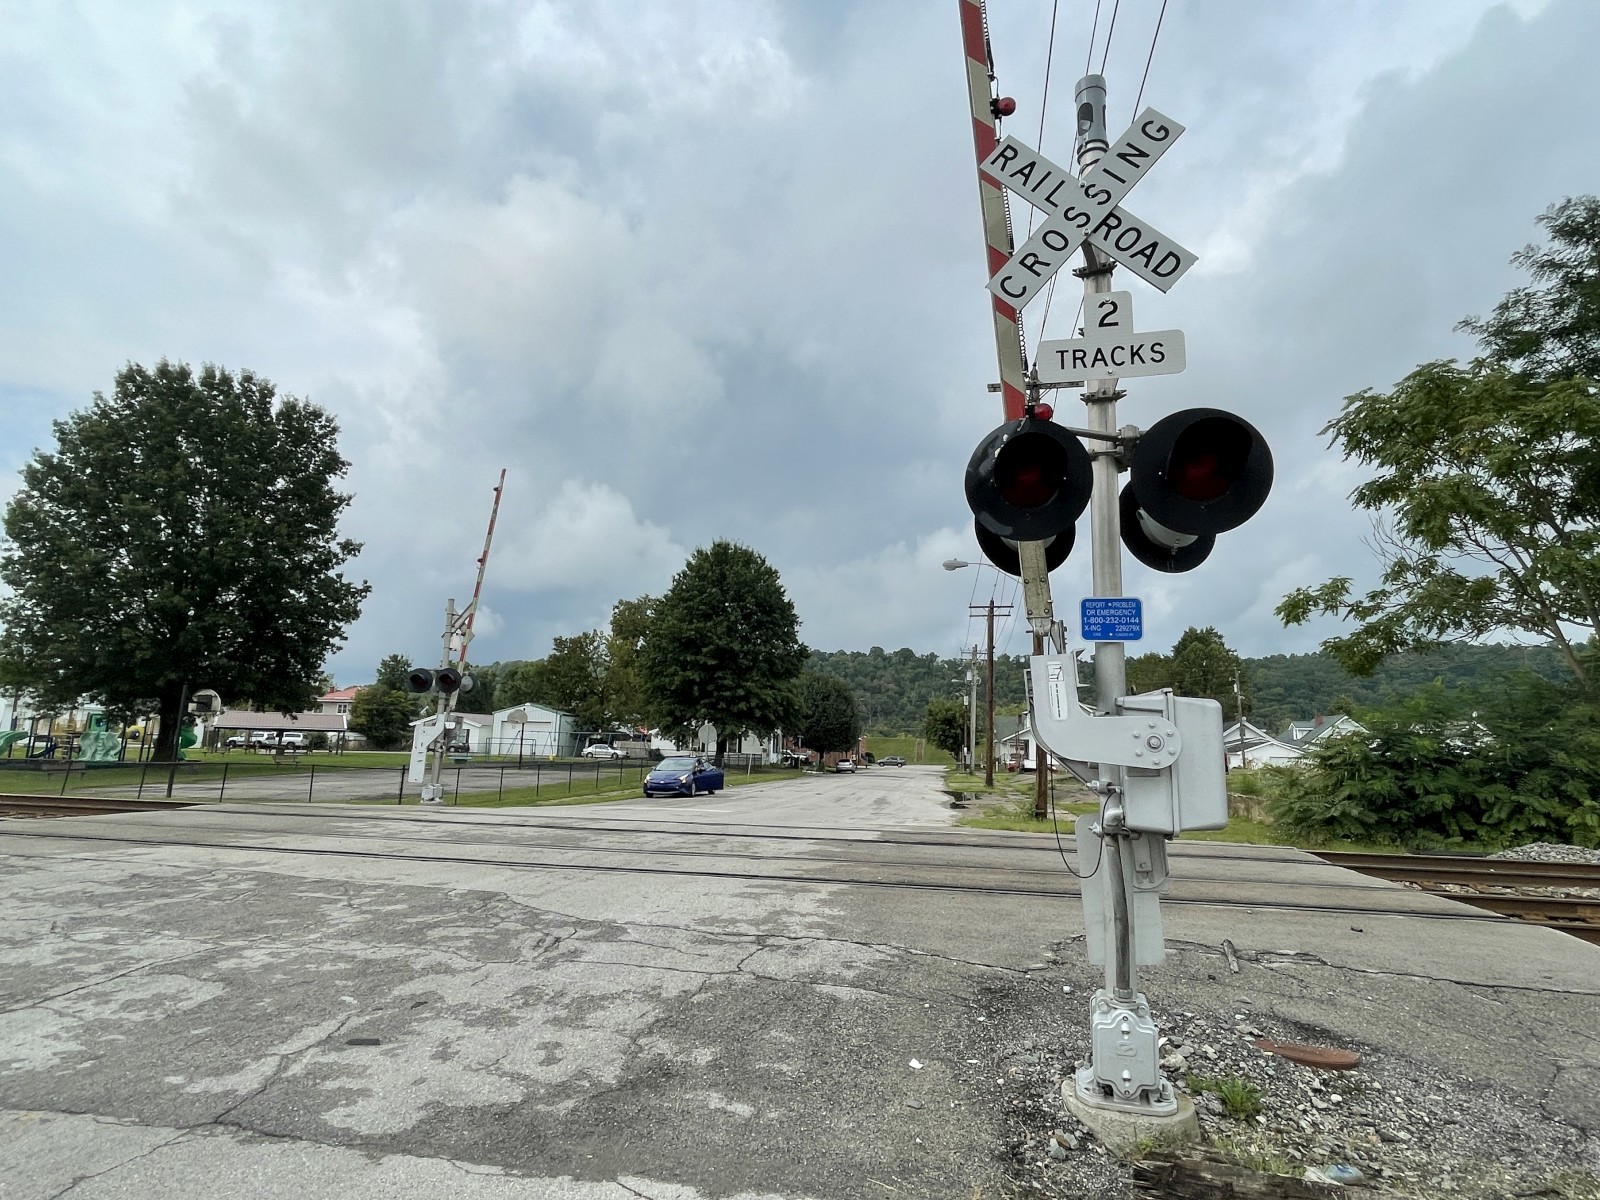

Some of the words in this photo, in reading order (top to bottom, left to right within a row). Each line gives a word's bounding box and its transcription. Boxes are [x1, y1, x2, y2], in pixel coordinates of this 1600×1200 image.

[990, 143, 1066, 208] RAIL
[1093, 211, 1182, 279] ROAD
[1000, 120, 1170, 299] CROSSING
[1097, 300, 1119, 328] 2
[1056, 342, 1166, 370] TRACKS
[1083, 616, 1140, 624] 1-800-232-0144
